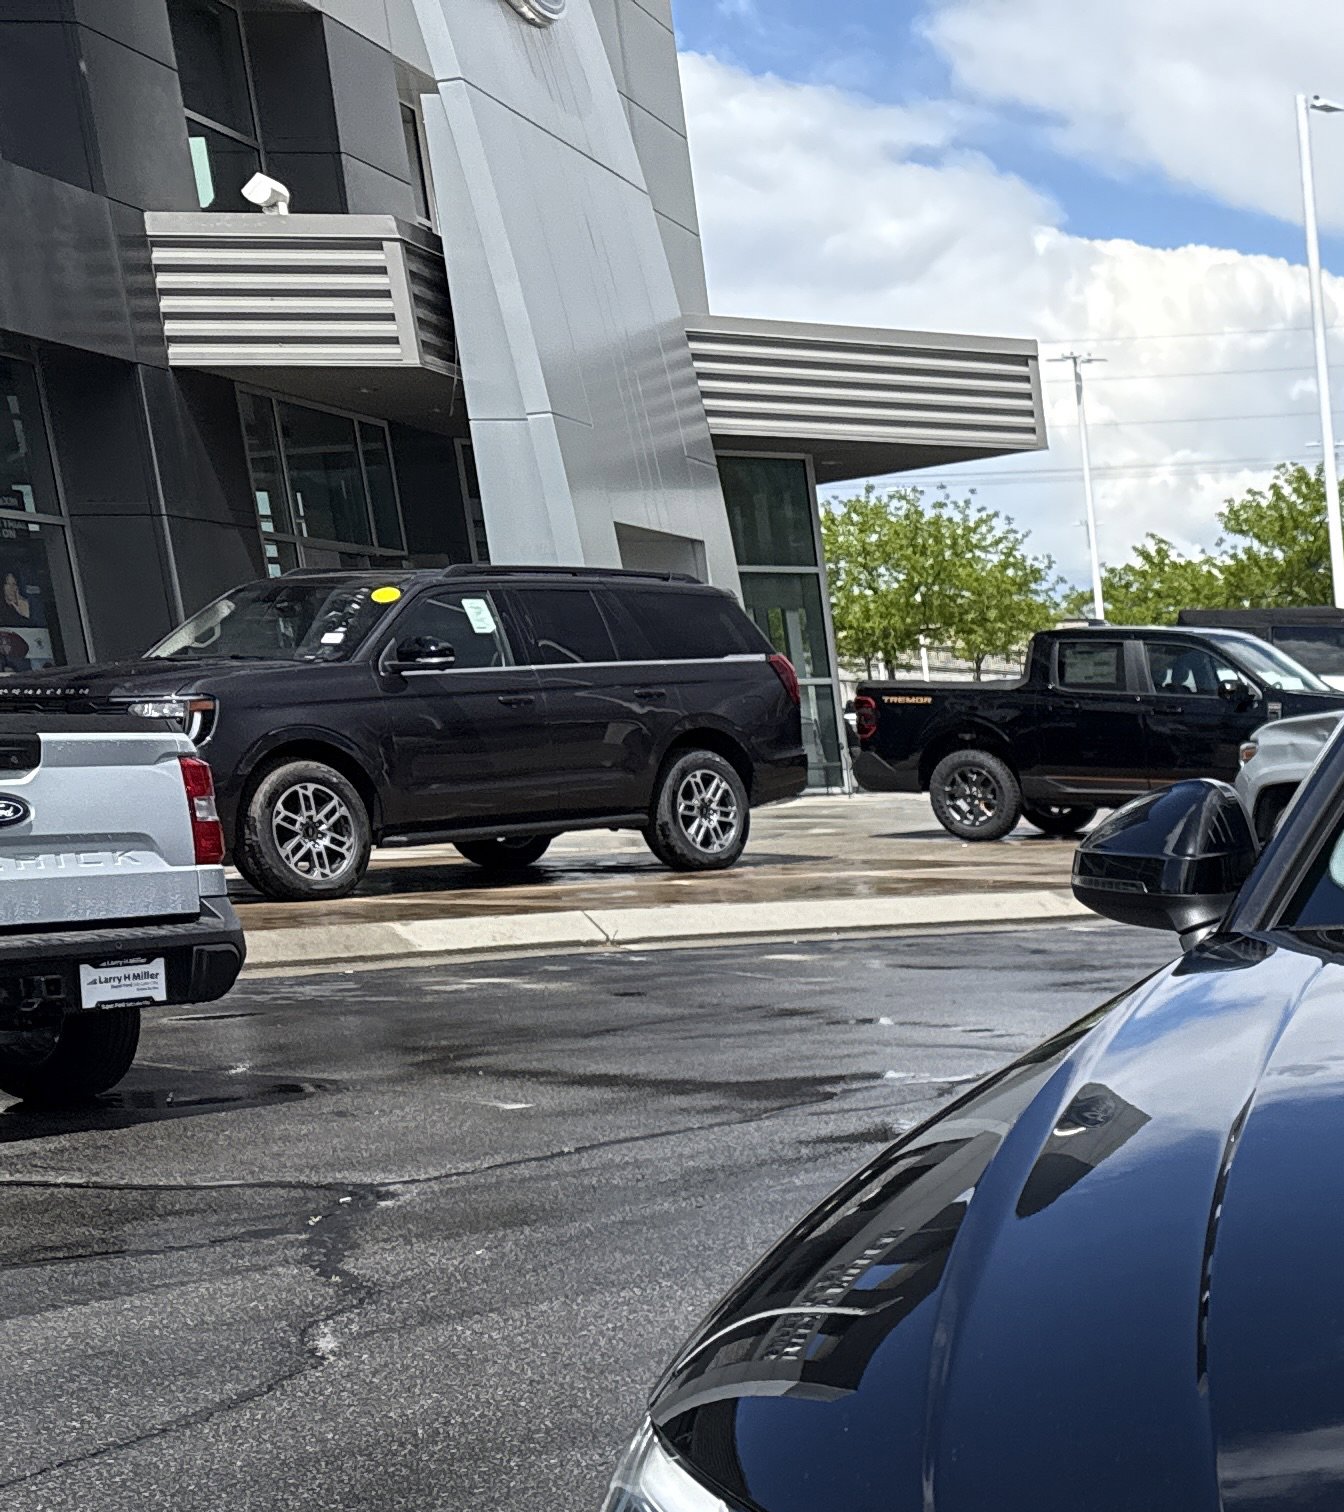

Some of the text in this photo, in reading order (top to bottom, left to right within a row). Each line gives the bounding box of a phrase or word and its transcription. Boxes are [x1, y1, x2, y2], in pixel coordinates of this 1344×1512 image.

[882, 695, 932, 704] TREMOR
[98, 971, 159, 984] Larry H Miller
